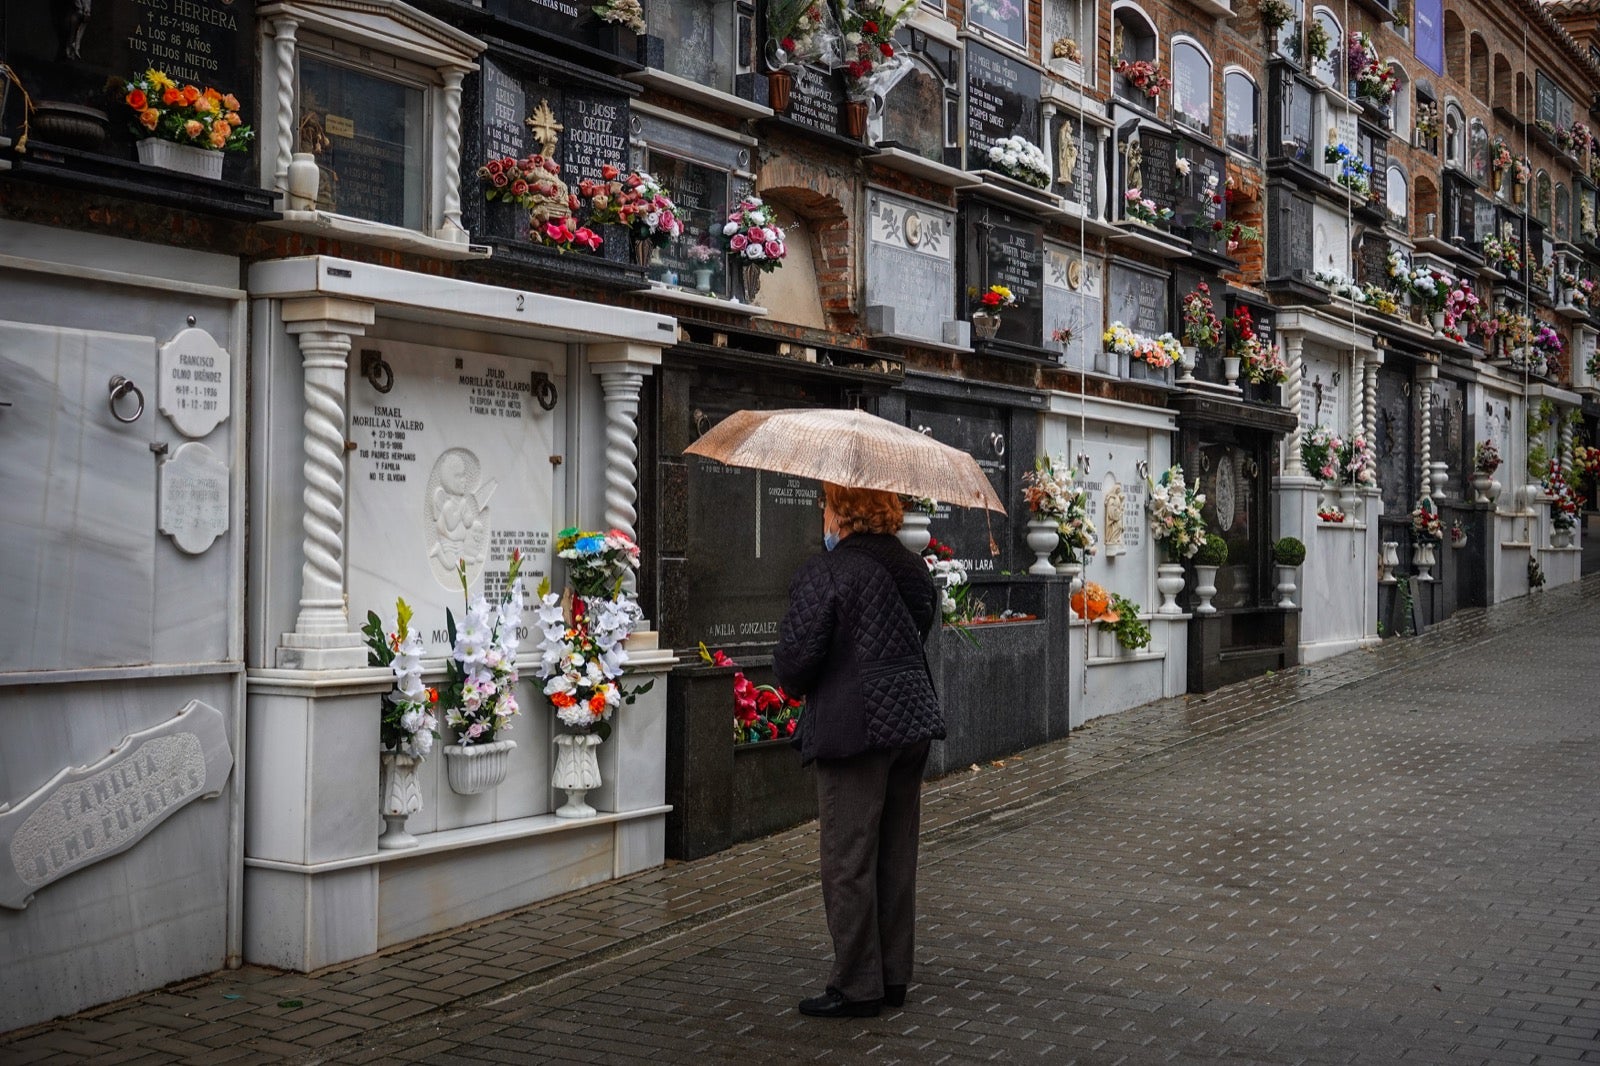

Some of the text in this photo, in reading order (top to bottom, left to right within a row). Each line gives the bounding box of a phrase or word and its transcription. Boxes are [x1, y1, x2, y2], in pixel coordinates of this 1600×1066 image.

[174, 0, 238, 31] HERRERA
[559, 3, 578, 18] VIDAS
[160, 15, 200, 36] 15-7-1986
[136, 24, 143, 36] A
[148, 26, 166, 42] LOS
[186, 37, 211, 54] AÑOS
[128, 37, 218, 71] TUS HIJOS NIETOS
[160, 61, 200, 81] FAMILIA
[591, 103, 617, 120] JOSE
[582, 116, 613, 134] ORTIZ
[570, 128, 625, 151] RODRIGUEZ
[577, 155, 591, 165] LOS
[565, 164, 579, 175] TUS
[582, 166, 603, 178] HIJOS
[516, 294, 525, 312] 2
[179, 354, 215, 368] FRANCISCO
[172, 368, 192, 380] OLMO
[486, 367, 505, 379] JULIO
[459, 375, 531, 393] MORILLAS GALLARDO
[374, 406, 402, 418] ISMAEL
[352, 415, 424, 431] MORILLAS VALERO
[371, 450, 390, 460] PADRES
[391, 452, 416, 461] HERMANOS
[381, 462, 401, 471] FAMILIA
[369, 472, 376, 481] NO
[975, 559, 994, 570] LARA
[739, 622, 777, 635] GONZALEZ
[62, 752, 159, 822] FAMILIA
